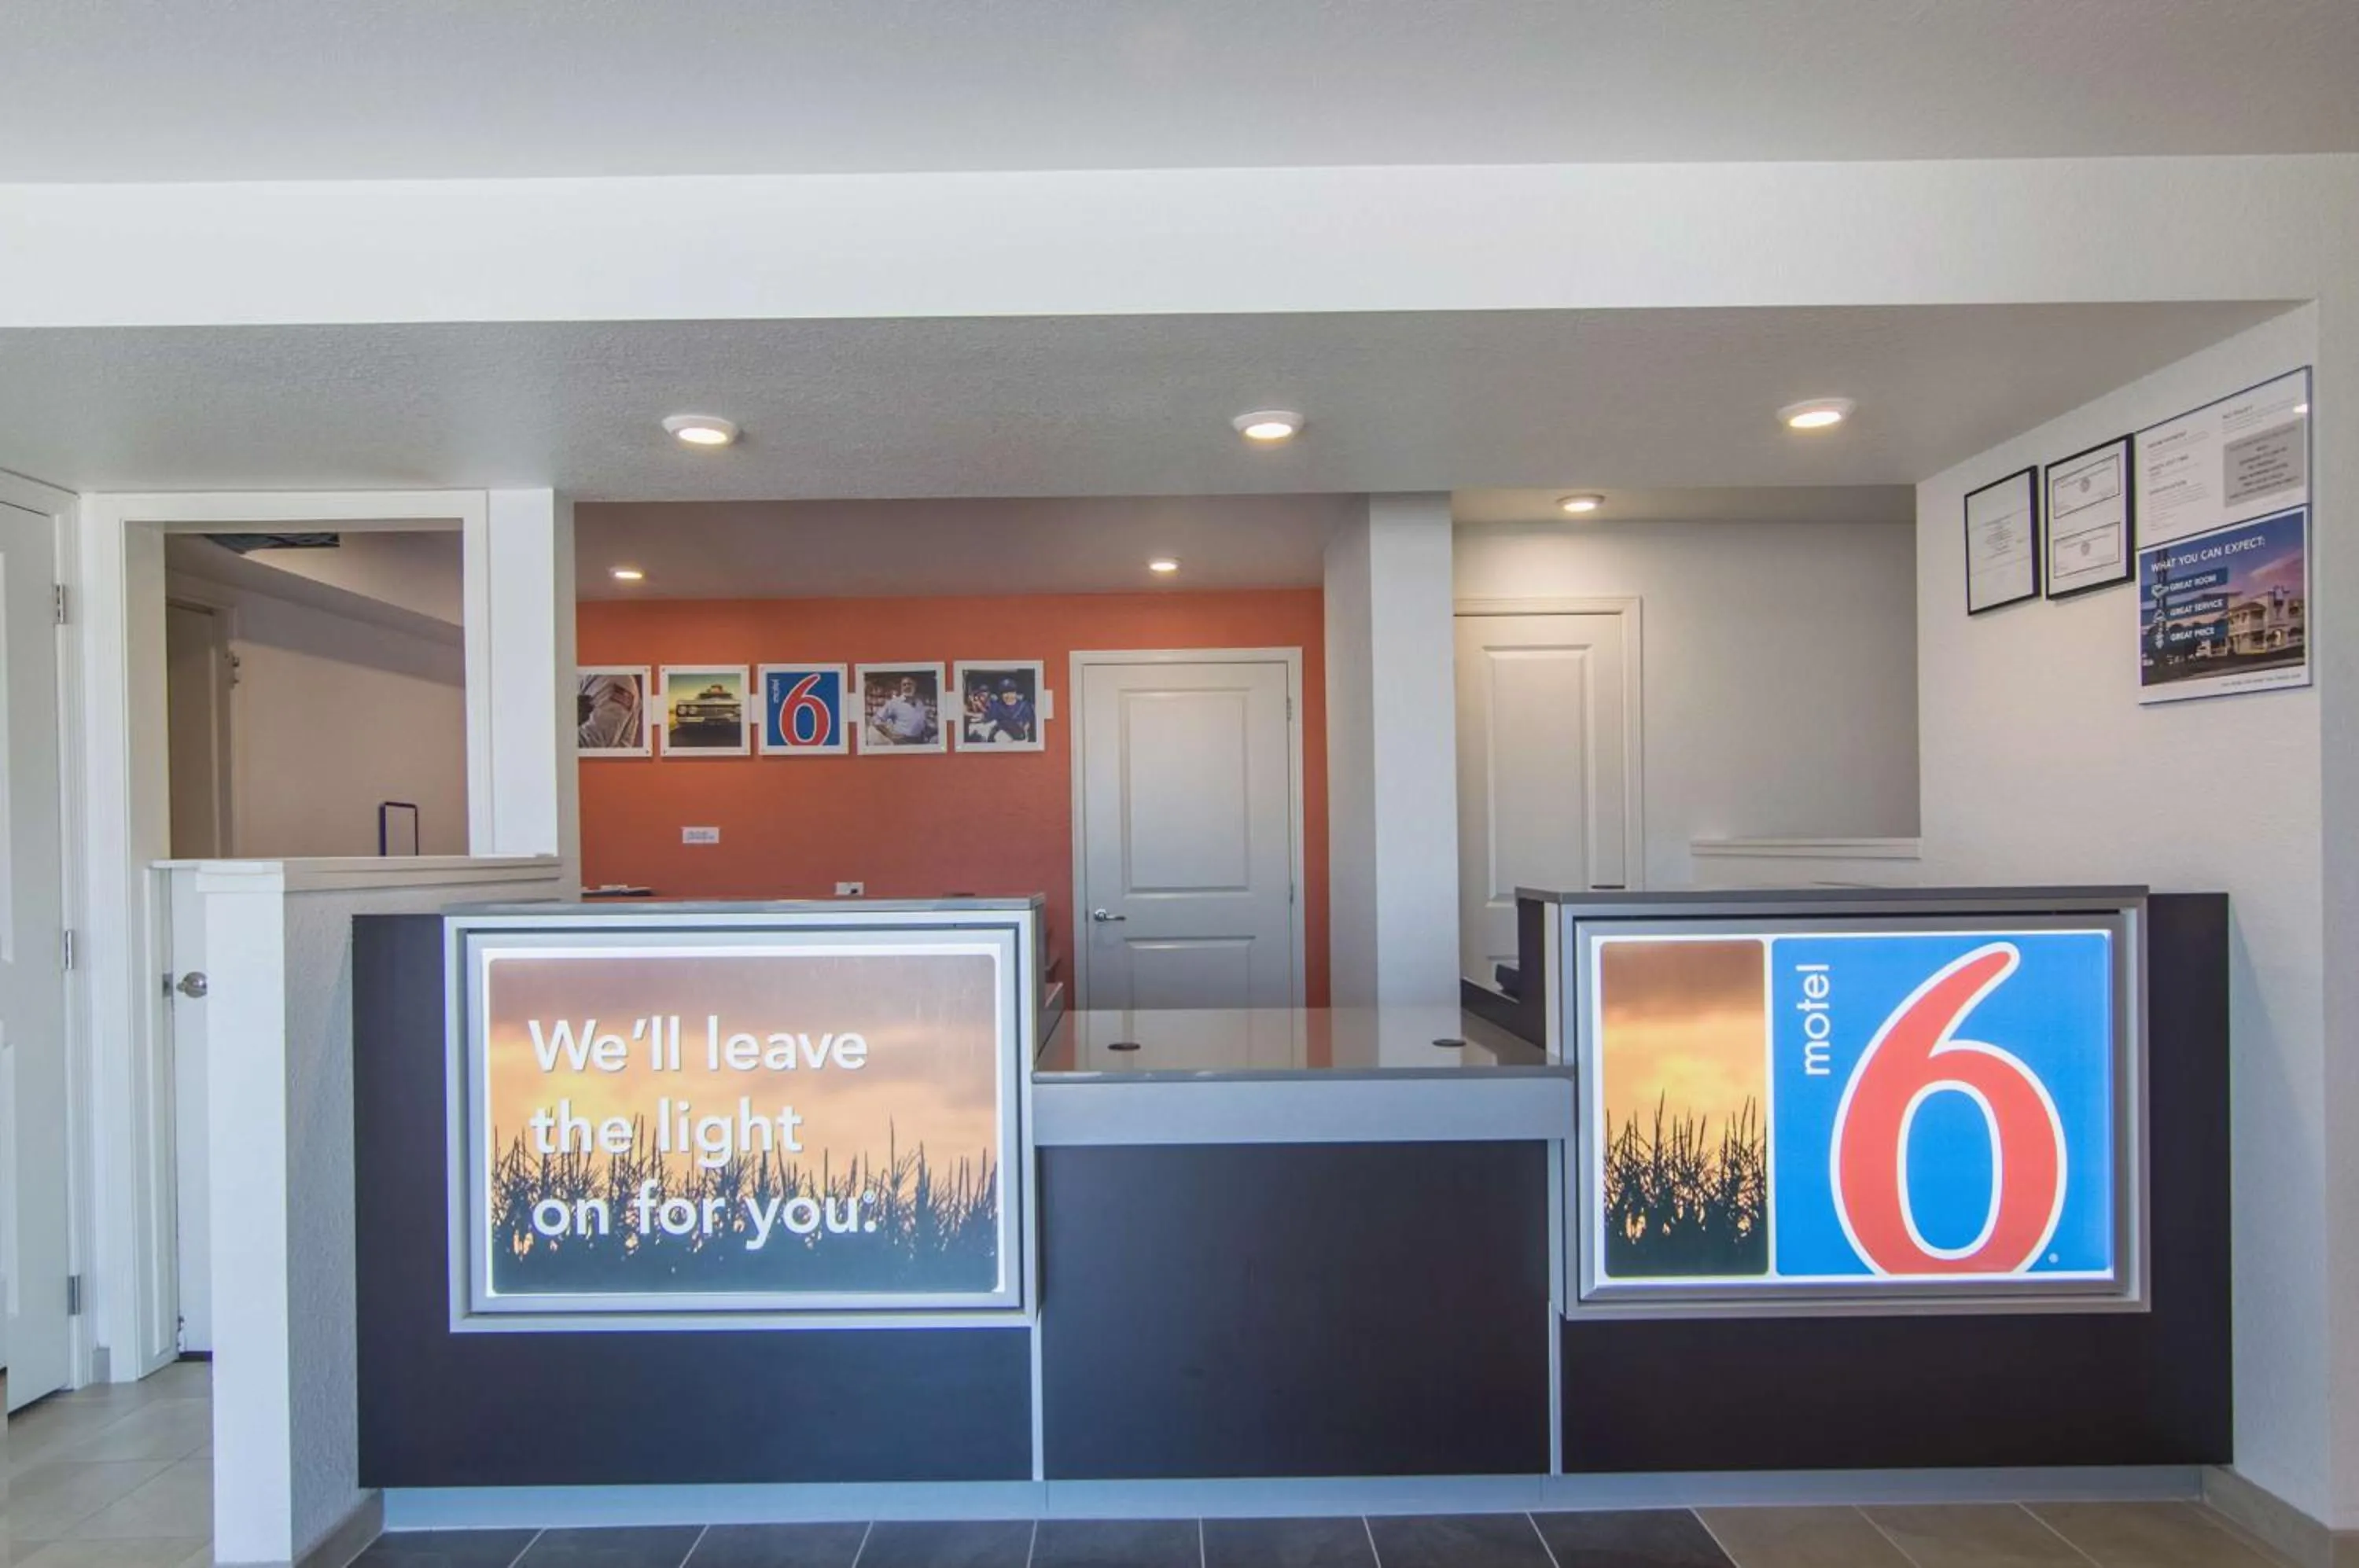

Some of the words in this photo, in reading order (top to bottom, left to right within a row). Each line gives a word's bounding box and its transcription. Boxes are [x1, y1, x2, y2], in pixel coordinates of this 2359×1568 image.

[2151, 558, 2176, 572] WHAT
[2179, 554, 2199, 565] YOU
[2201, 547, 2222, 561] CAN
[2169, 580, 2193, 592] GREAT
[2194, 574, 2217, 587] ROOM
[2169, 605, 2193, 617] GREAT
[2195, 598, 2224, 611] SERVICE
[2169, 630, 2193, 642] GREAT
[2194, 627, 2215, 638] PRICE
[779, 673, 831, 746] 6
[528, 1016, 681, 1072] We'll
[708, 1015, 868, 1070] leave
[1796, 964, 1830, 1076] motel
[529, 1099, 633, 1154] the
[658, 1096, 803, 1168] light
[1830, 941, 2067, 1275] 6
[532, 1195, 609, 1236] on
[639, 1180, 727, 1235] for
